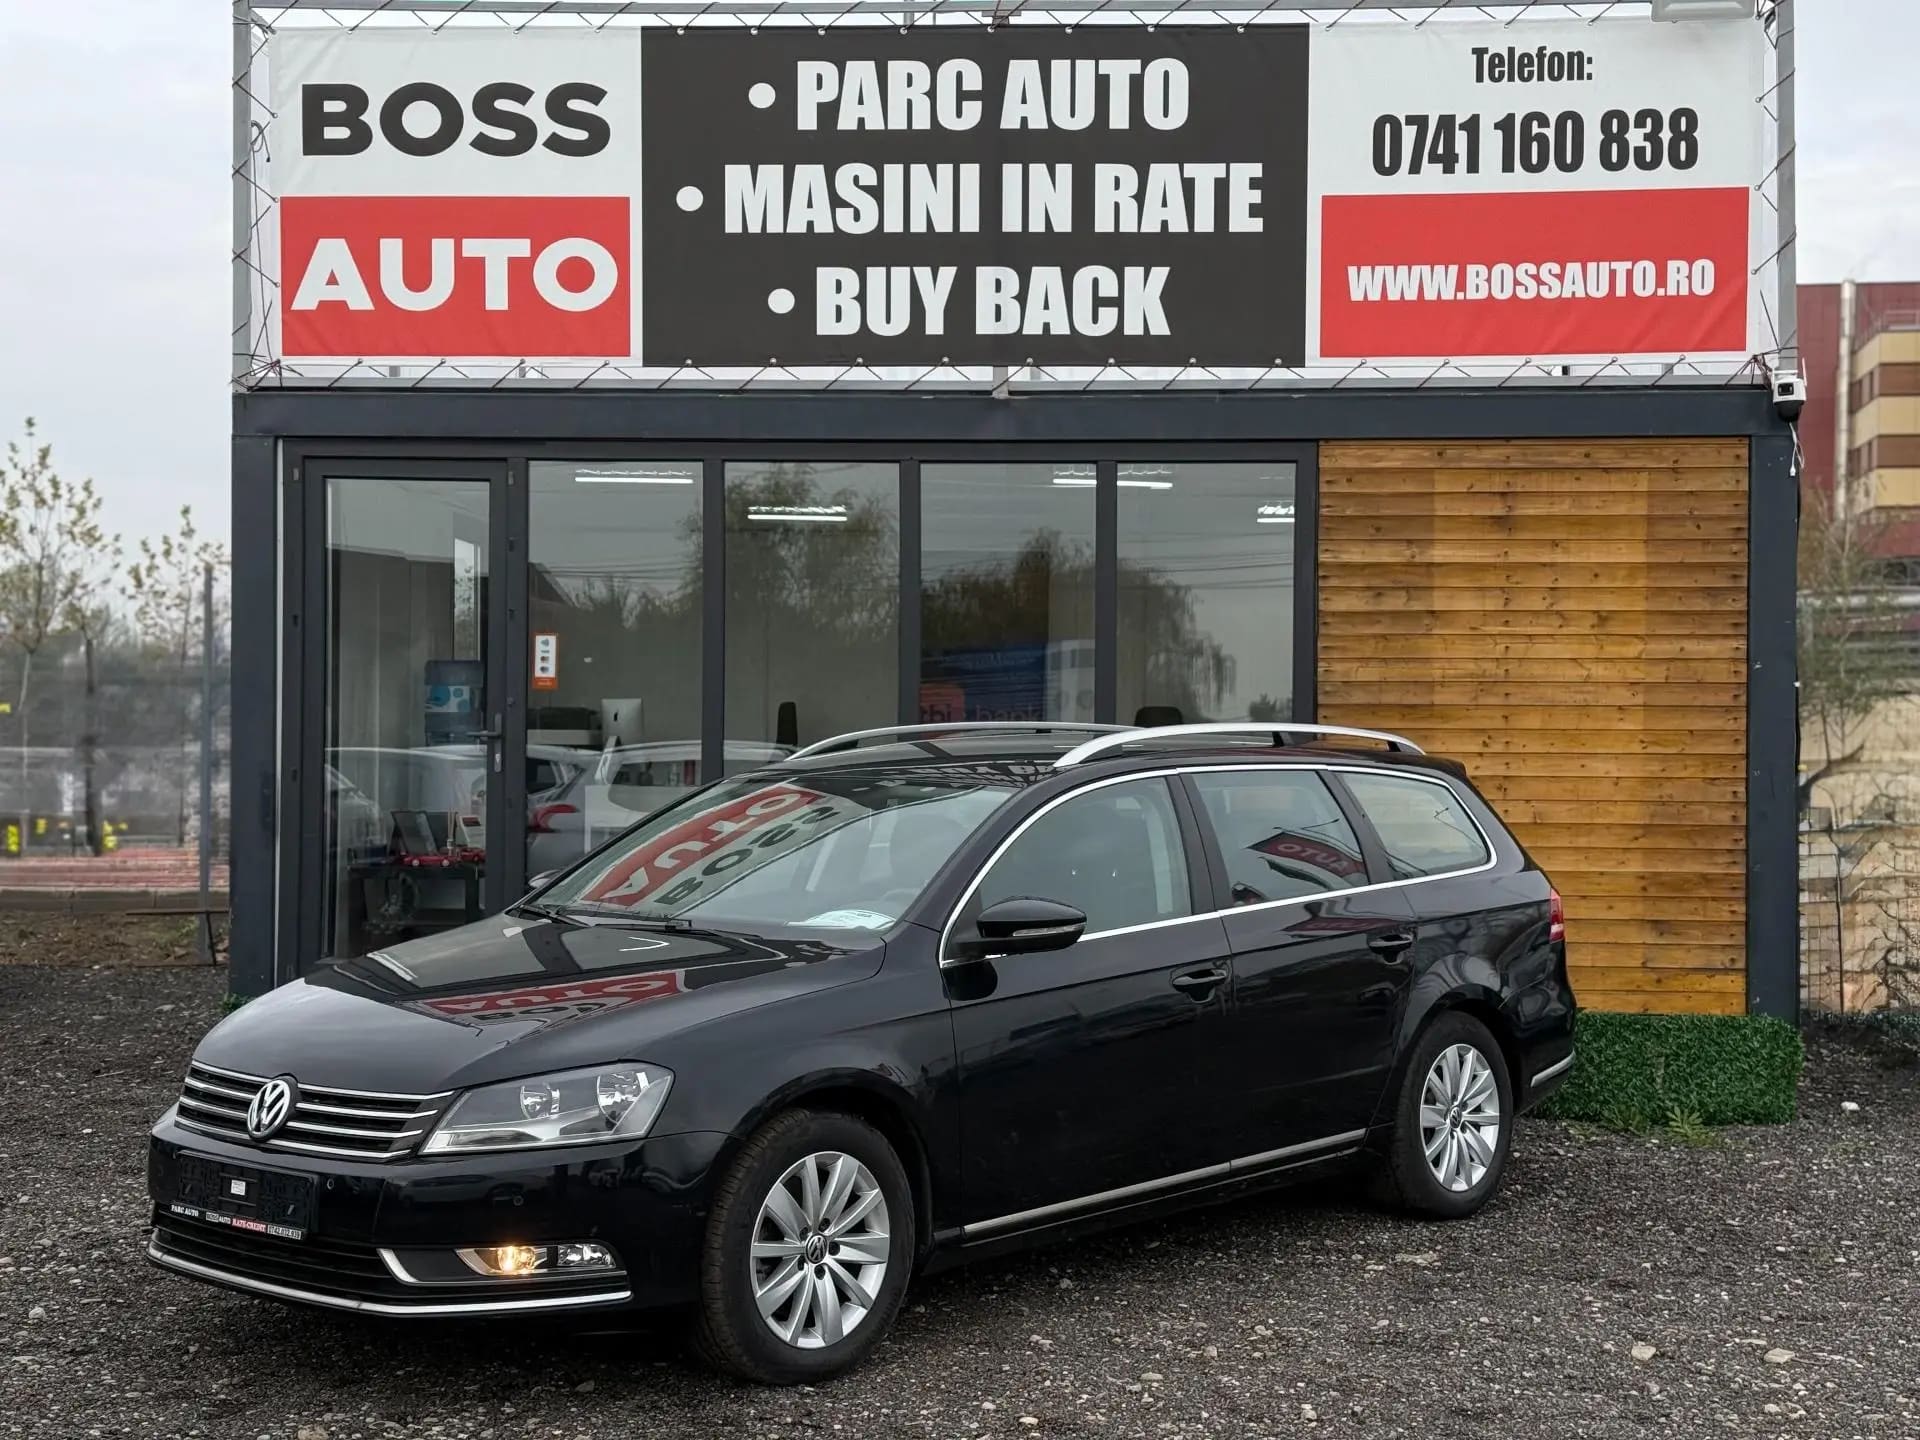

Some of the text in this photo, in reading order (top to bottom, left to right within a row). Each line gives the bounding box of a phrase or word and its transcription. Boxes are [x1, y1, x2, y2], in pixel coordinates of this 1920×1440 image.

[798, 58, 1190, 131] PARC AUTO
[1472, 46, 1593, 84] Telefon:
[302, 83, 611, 157] BOSS
[1373, 107, 1699, 177] 0741 160 838
[725, 163, 1264, 235] MASINI IN RATE
[291, 237, 619, 312] AUTO
[817, 264, 1171, 337] BUY BACK
[1348, 259, 1715, 302] WWW.BOSSAUTO.RO
